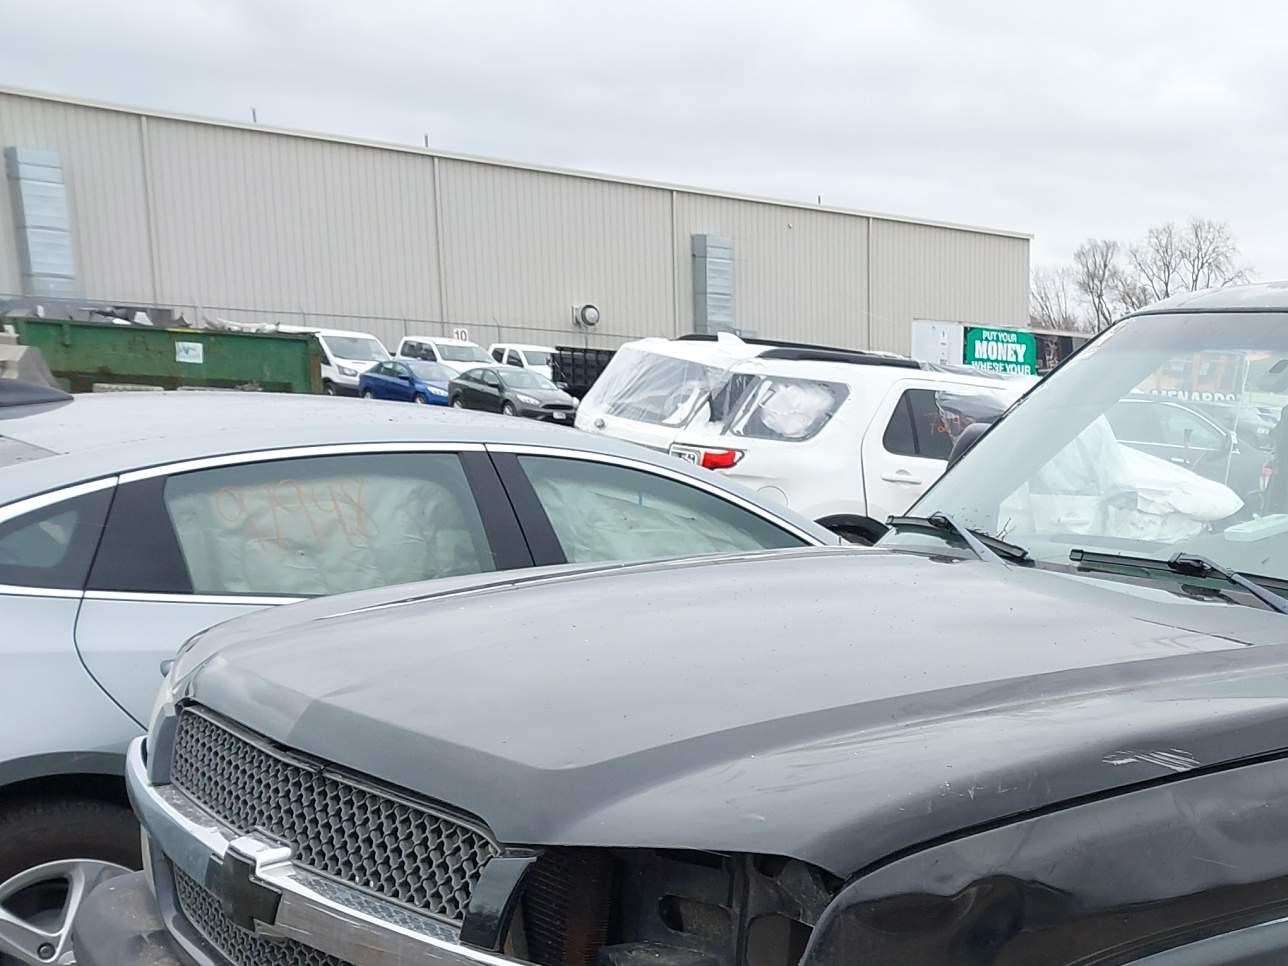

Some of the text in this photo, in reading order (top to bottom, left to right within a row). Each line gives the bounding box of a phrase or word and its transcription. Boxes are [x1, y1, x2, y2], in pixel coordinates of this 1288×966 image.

[454, 330, 467, 342] 10
[982, 330, 1017, 343] PUT YOUR
[974, 339, 1027, 363] MONEY
[1005, 362, 1031, 376] YOUR
